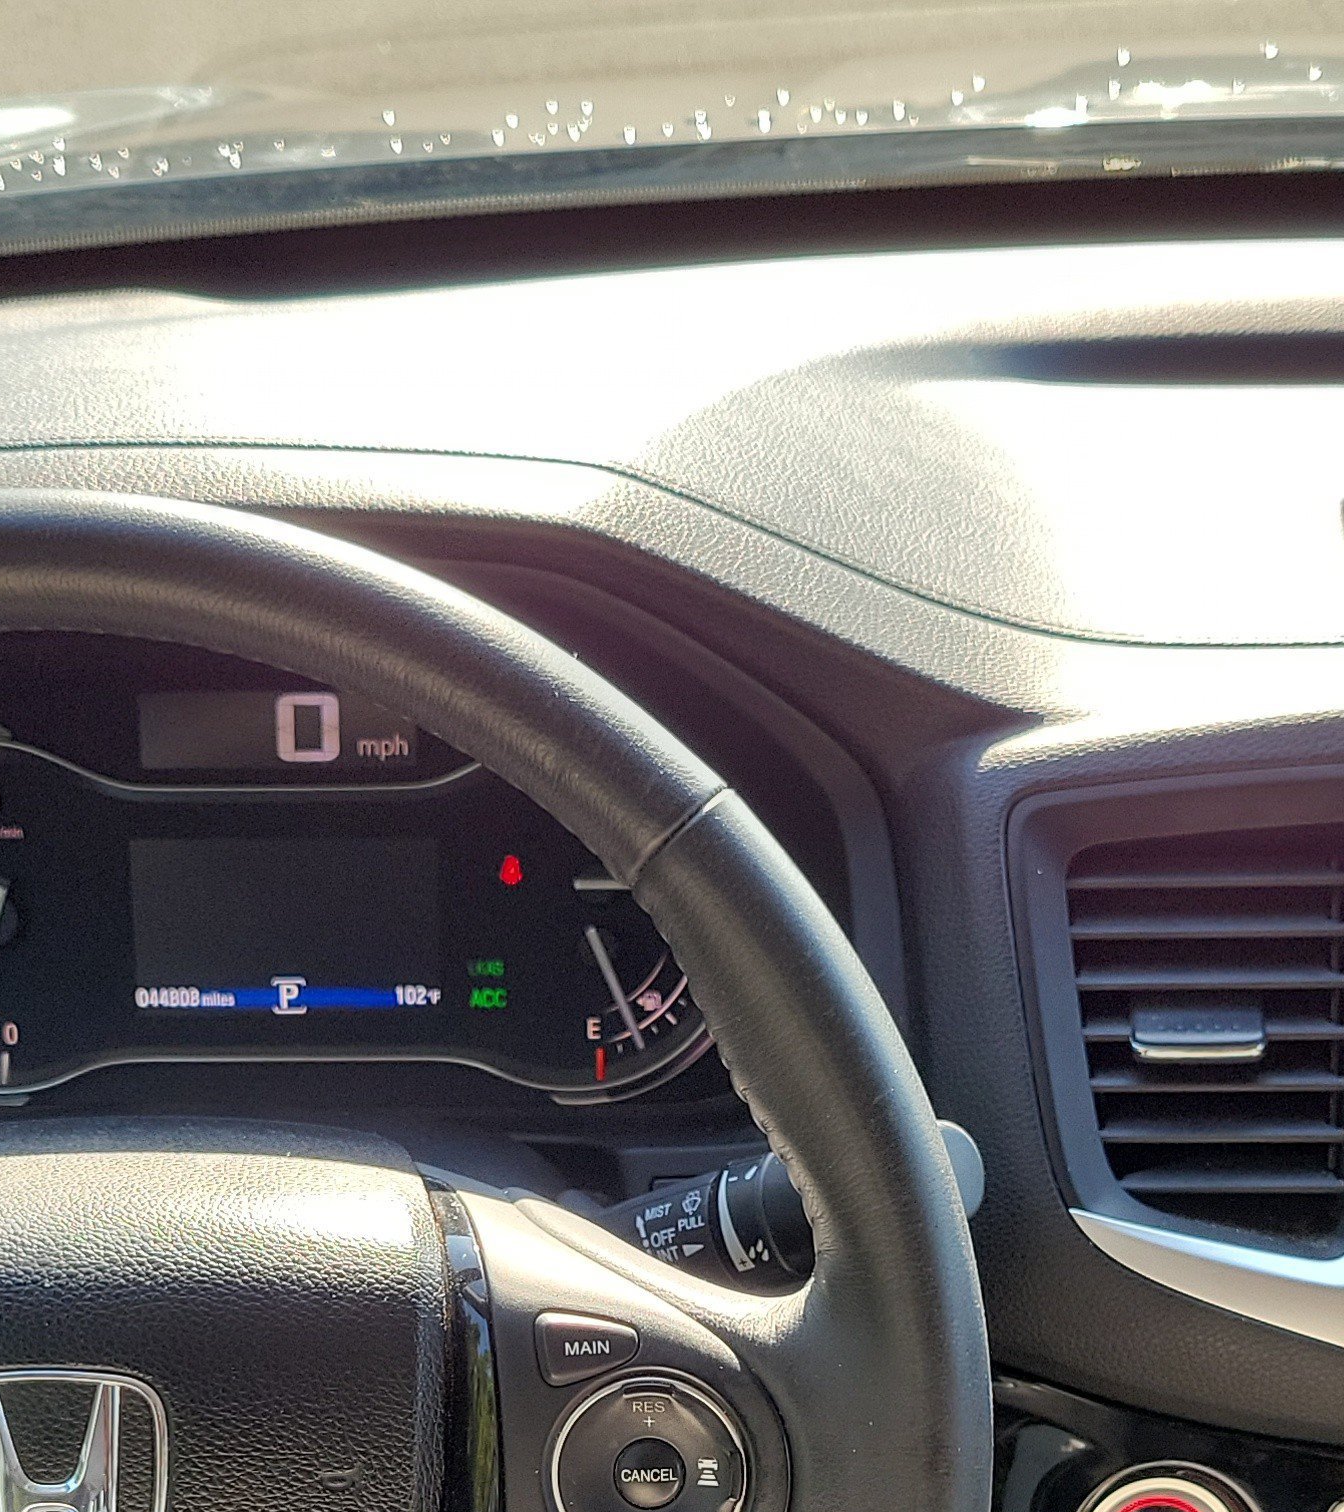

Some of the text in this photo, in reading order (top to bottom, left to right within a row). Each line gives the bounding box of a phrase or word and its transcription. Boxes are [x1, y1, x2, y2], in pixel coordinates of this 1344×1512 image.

[276, 692, 409, 762] 0 mph
[200, 990, 235, 1007] miles
[277, 985, 299, 1009] P
[470, 988, 506, 1008] ACC
[2, 1021, 19, 1046] 0
[587, 1017, 601, 1040] E
[644, 1202, 672, 1221] MIST
[677, 1215, 705, 1232] PULL
[651, 1228, 676, 1248] OFF
[564, 1340, 610, 1356] MAIN
[632, 1401, 665, 1413] RES
[621, 1468, 678, 1483] CANCEL
